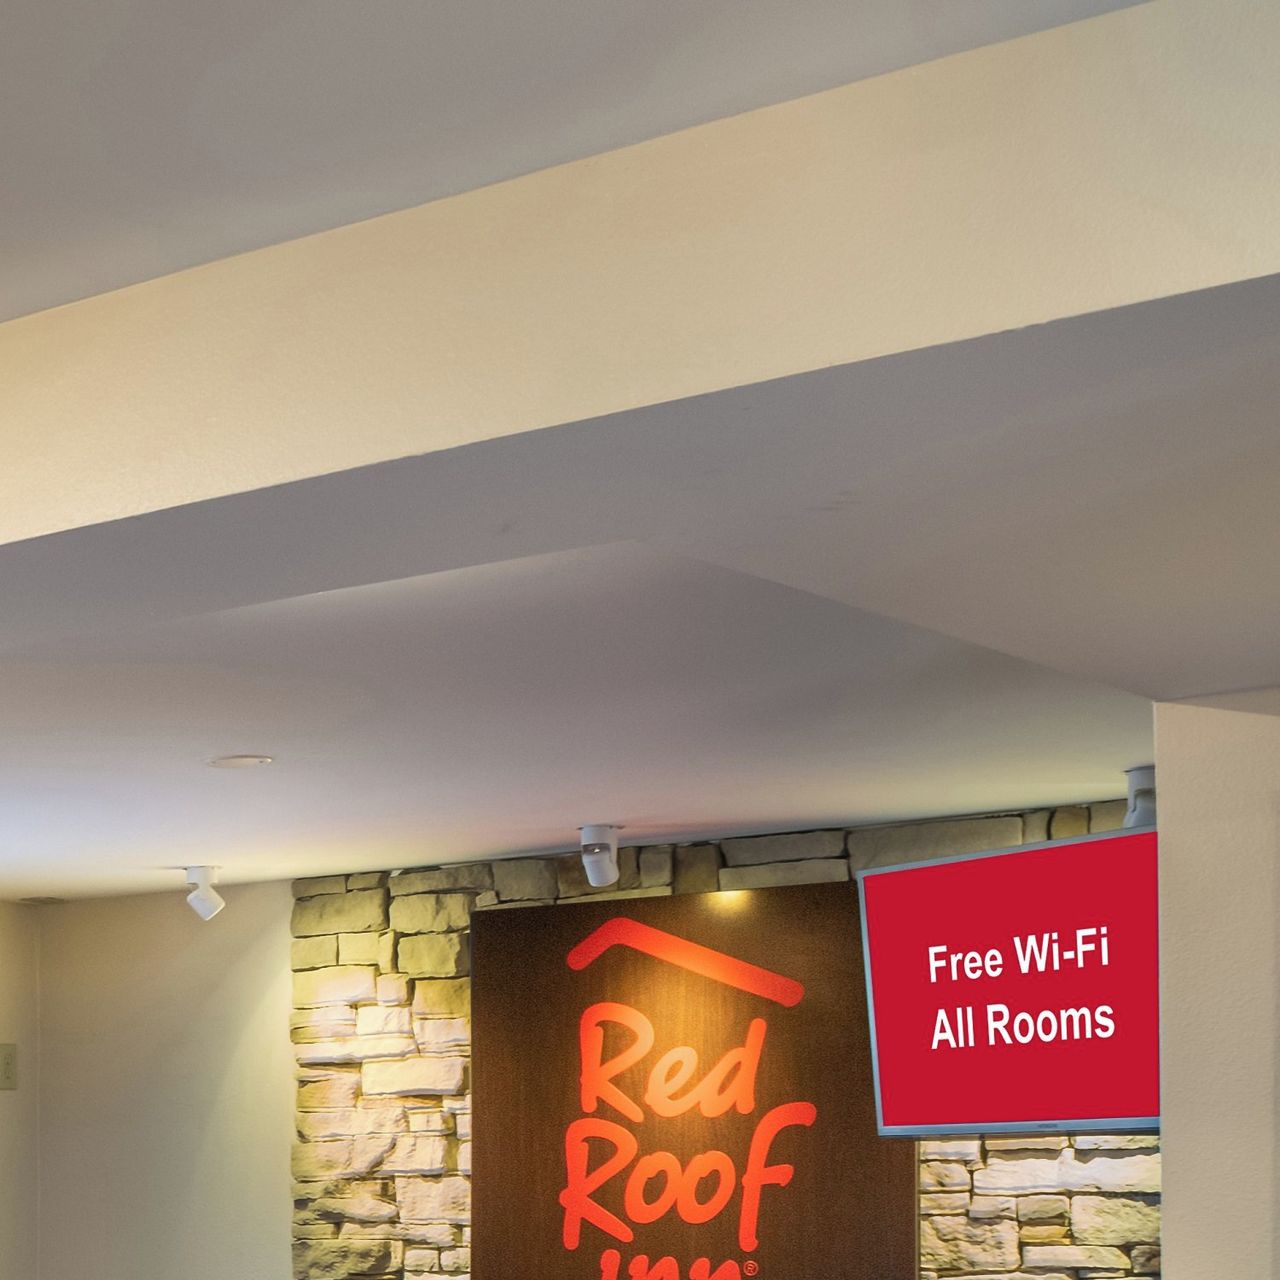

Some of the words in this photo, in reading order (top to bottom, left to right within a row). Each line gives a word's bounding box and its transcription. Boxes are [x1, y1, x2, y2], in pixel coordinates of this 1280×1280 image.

[928, 945, 1004, 983] Free
[1013, 926, 1109, 974] Wi-Fi
[579, 1001, 767, 1123] Red
[931, 1006, 975, 1050] All
[986, 1003, 1116, 1045] Rooms
[559, 1101, 817, 1252] Roof
